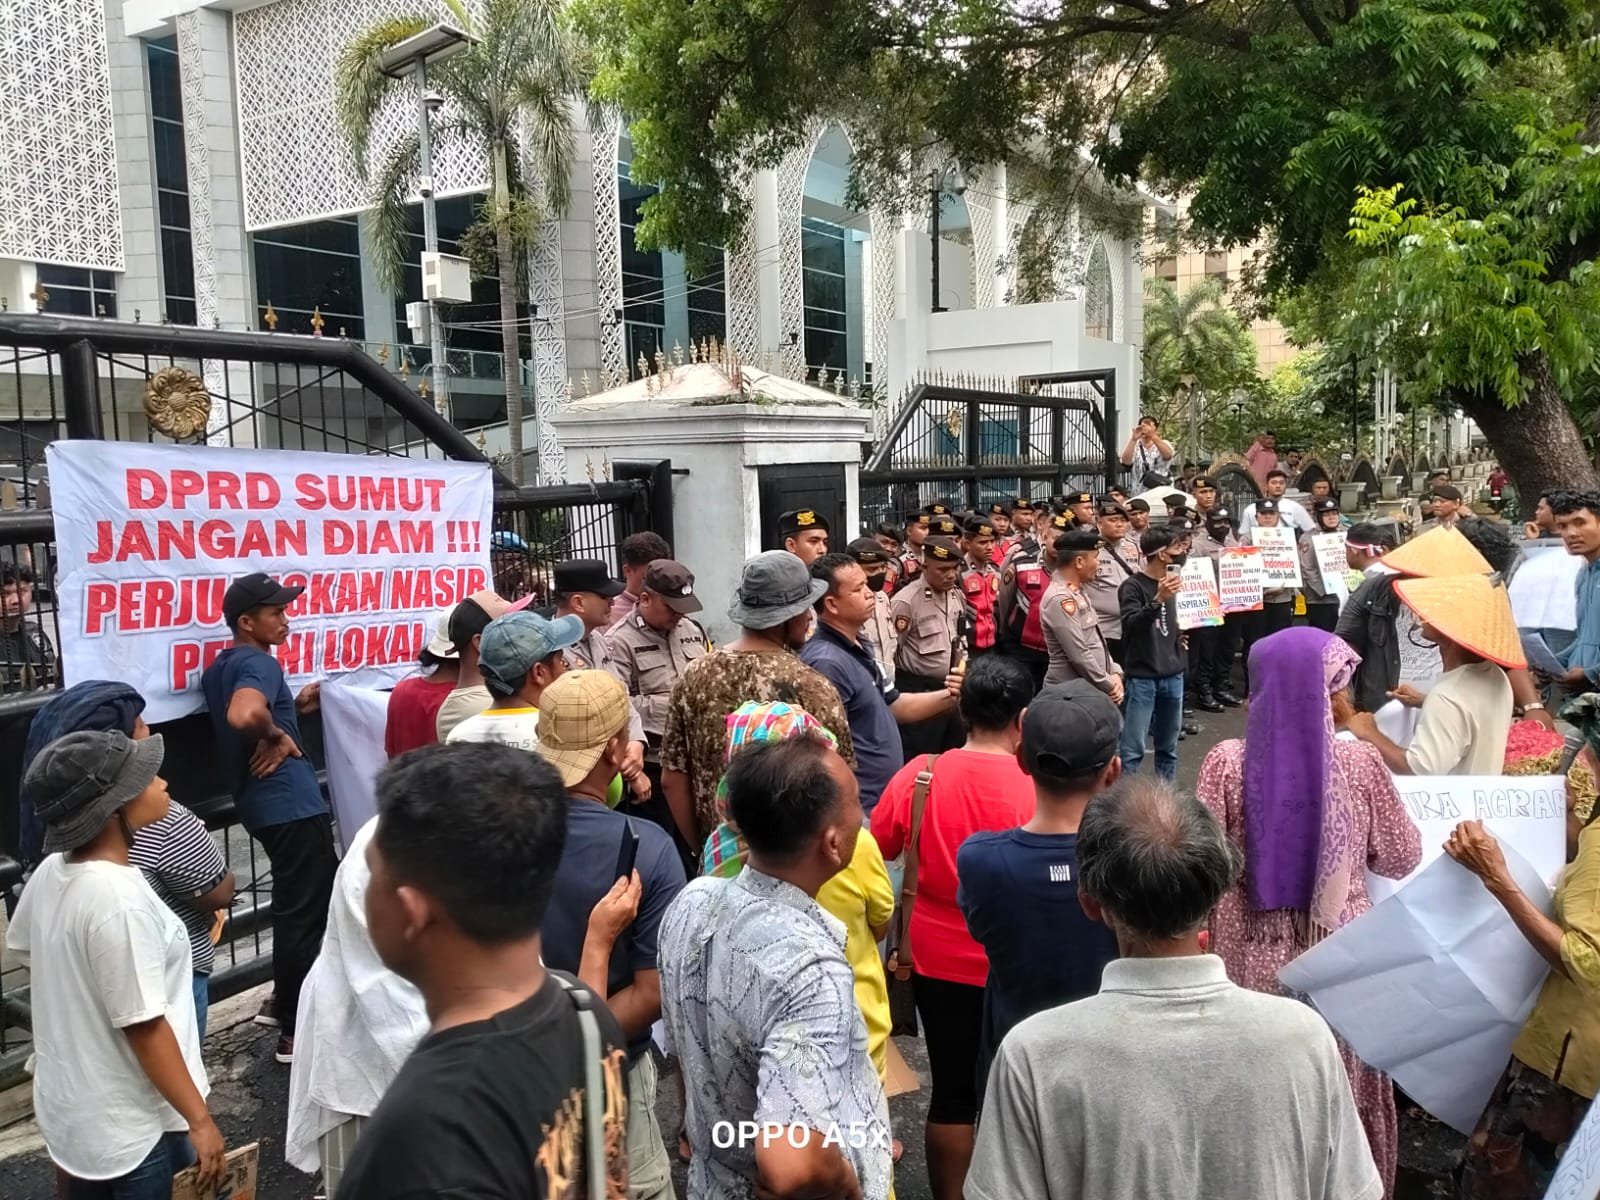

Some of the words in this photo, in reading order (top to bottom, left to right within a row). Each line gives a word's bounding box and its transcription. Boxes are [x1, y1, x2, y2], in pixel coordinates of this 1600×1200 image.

[126, 468, 281, 510] DPRD
[295, 473, 446, 512] SUMUT
[87, 518, 308, 564] JANGAN
[323, 520, 434, 555] DIAM
[1263, 557, 1295, 568] Indonesia
[84, 570, 385, 634] PERJUGKAN
[1177, 598, 1210, 610] ASPIRASI
[1234, 595, 1261, 603] DEWASA
